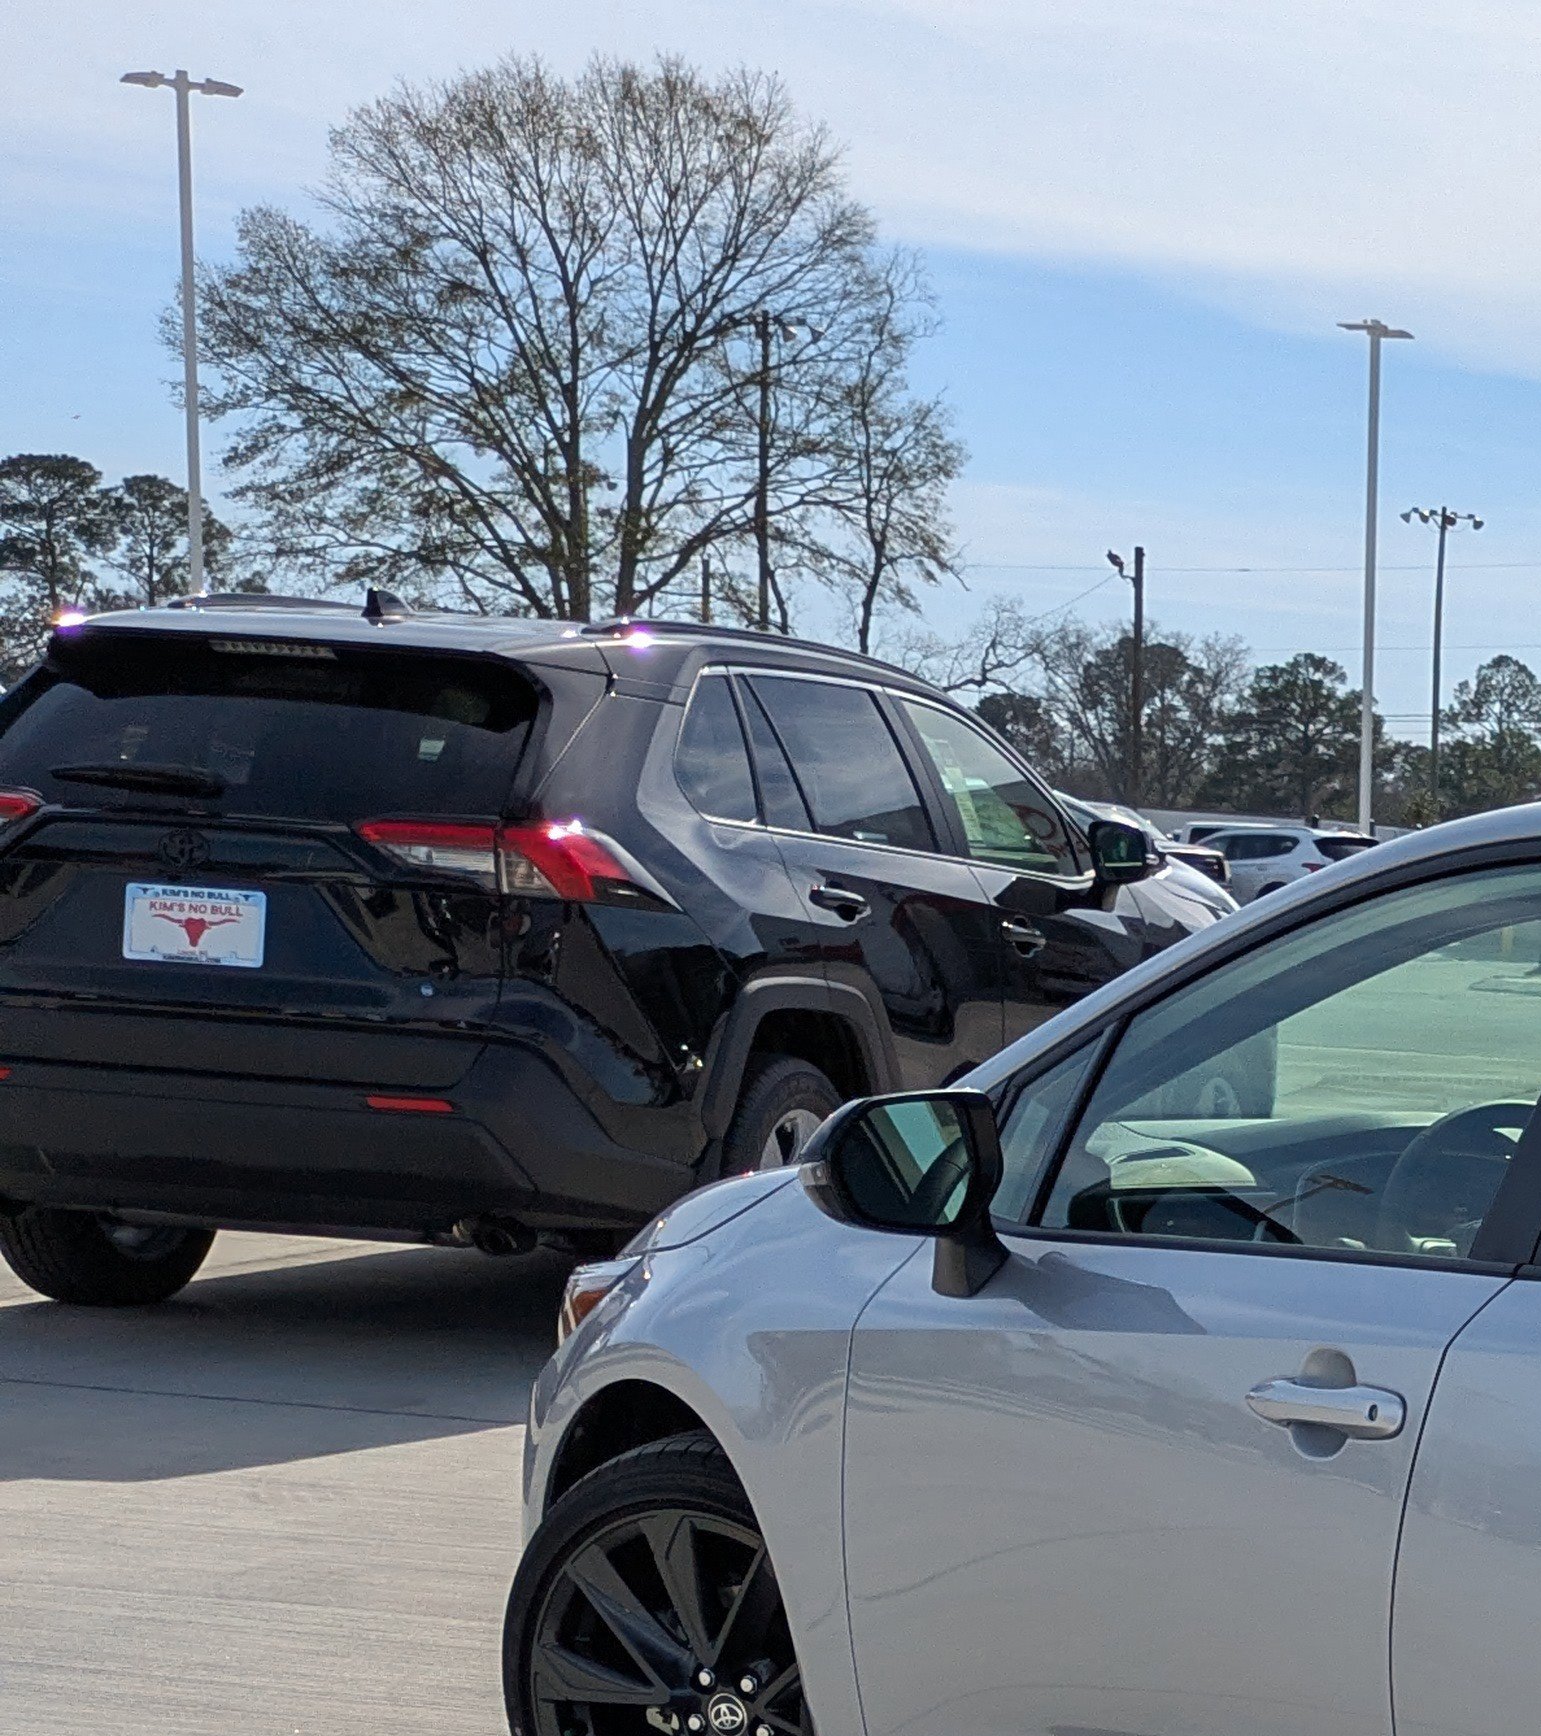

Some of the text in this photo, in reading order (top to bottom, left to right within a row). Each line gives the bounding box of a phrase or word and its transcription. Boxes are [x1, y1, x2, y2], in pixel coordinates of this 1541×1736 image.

[149, 901, 243, 917] KIM'S NO BULL
